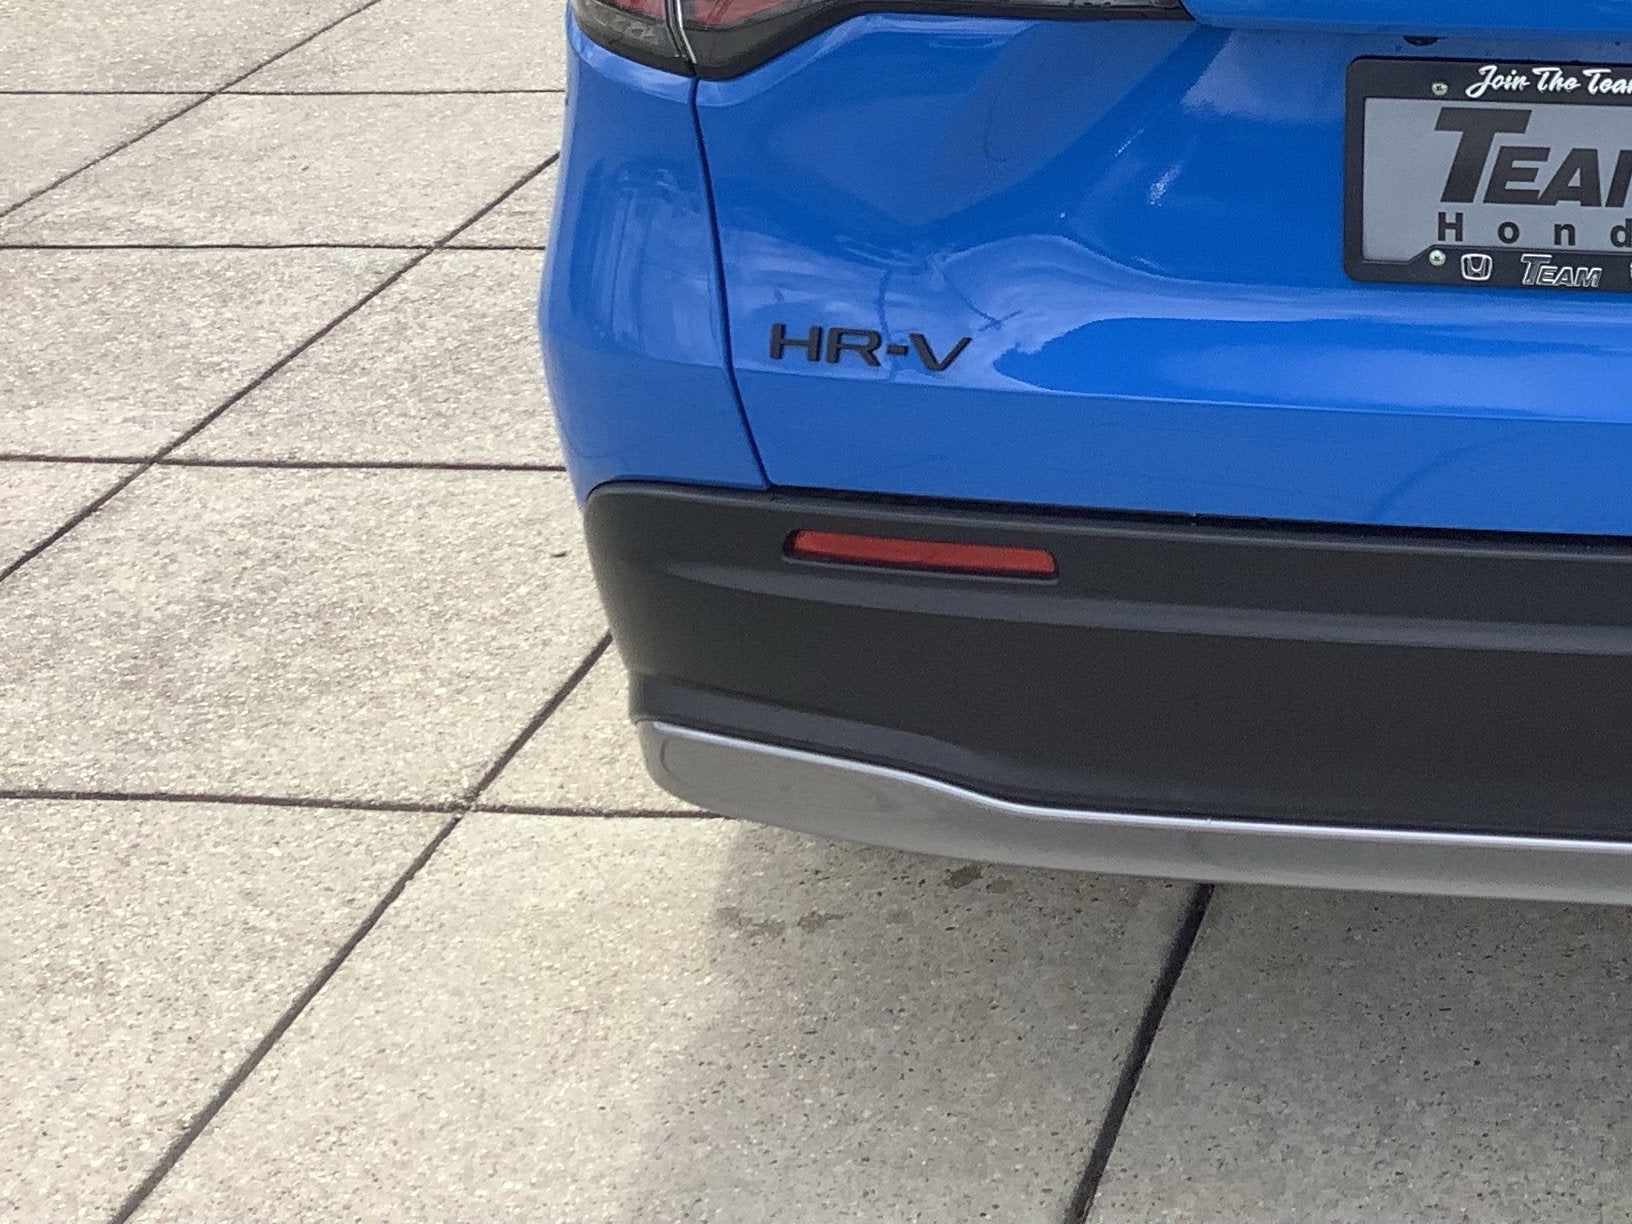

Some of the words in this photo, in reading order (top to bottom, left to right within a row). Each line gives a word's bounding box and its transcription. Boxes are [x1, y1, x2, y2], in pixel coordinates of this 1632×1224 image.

[1466, 65, 1530, 98] Join
[1532, 67, 1581, 93] The
[1521, 254, 1602, 288] TEAM
[768, 323, 972, 372] HR-V
